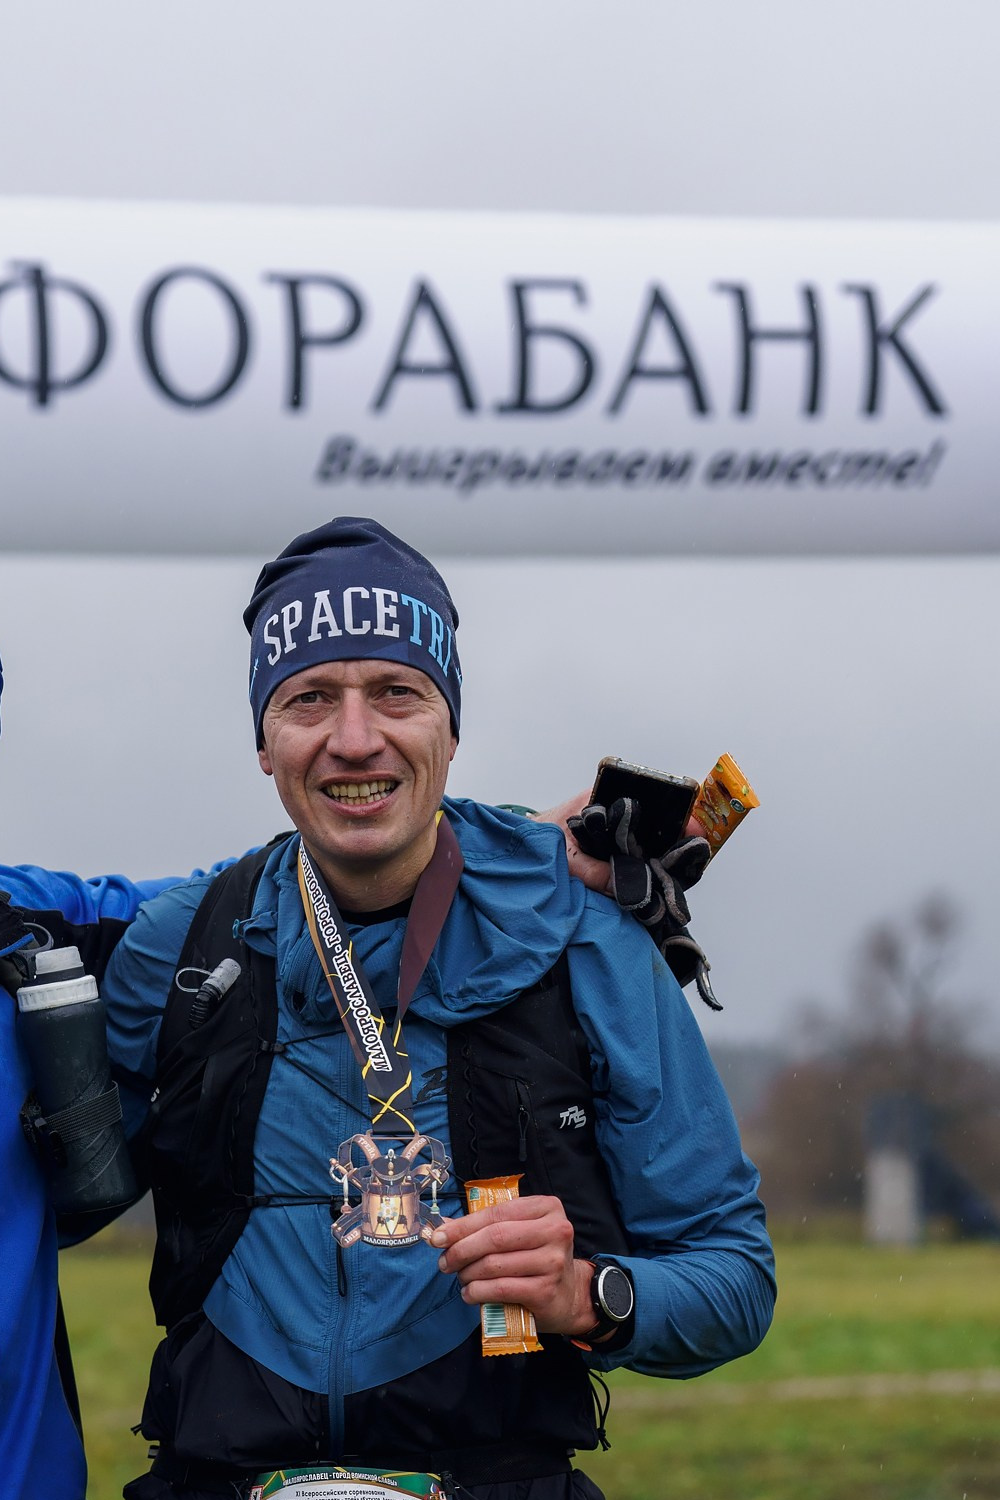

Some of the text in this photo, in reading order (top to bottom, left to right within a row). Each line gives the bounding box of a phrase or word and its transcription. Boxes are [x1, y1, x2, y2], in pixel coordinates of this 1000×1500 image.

[312, 896, 341, 948] ГОРОД
[333, 949, 392, 1072] МАЛОЯРОСЛАВЕЦ
[344, 1230, 359, 1244] 1812
[363, 1235, 419, 1246] МАЛОЯРОСЛАВЕЦ
[302, 1489, 347, 1498] Всероссийские
